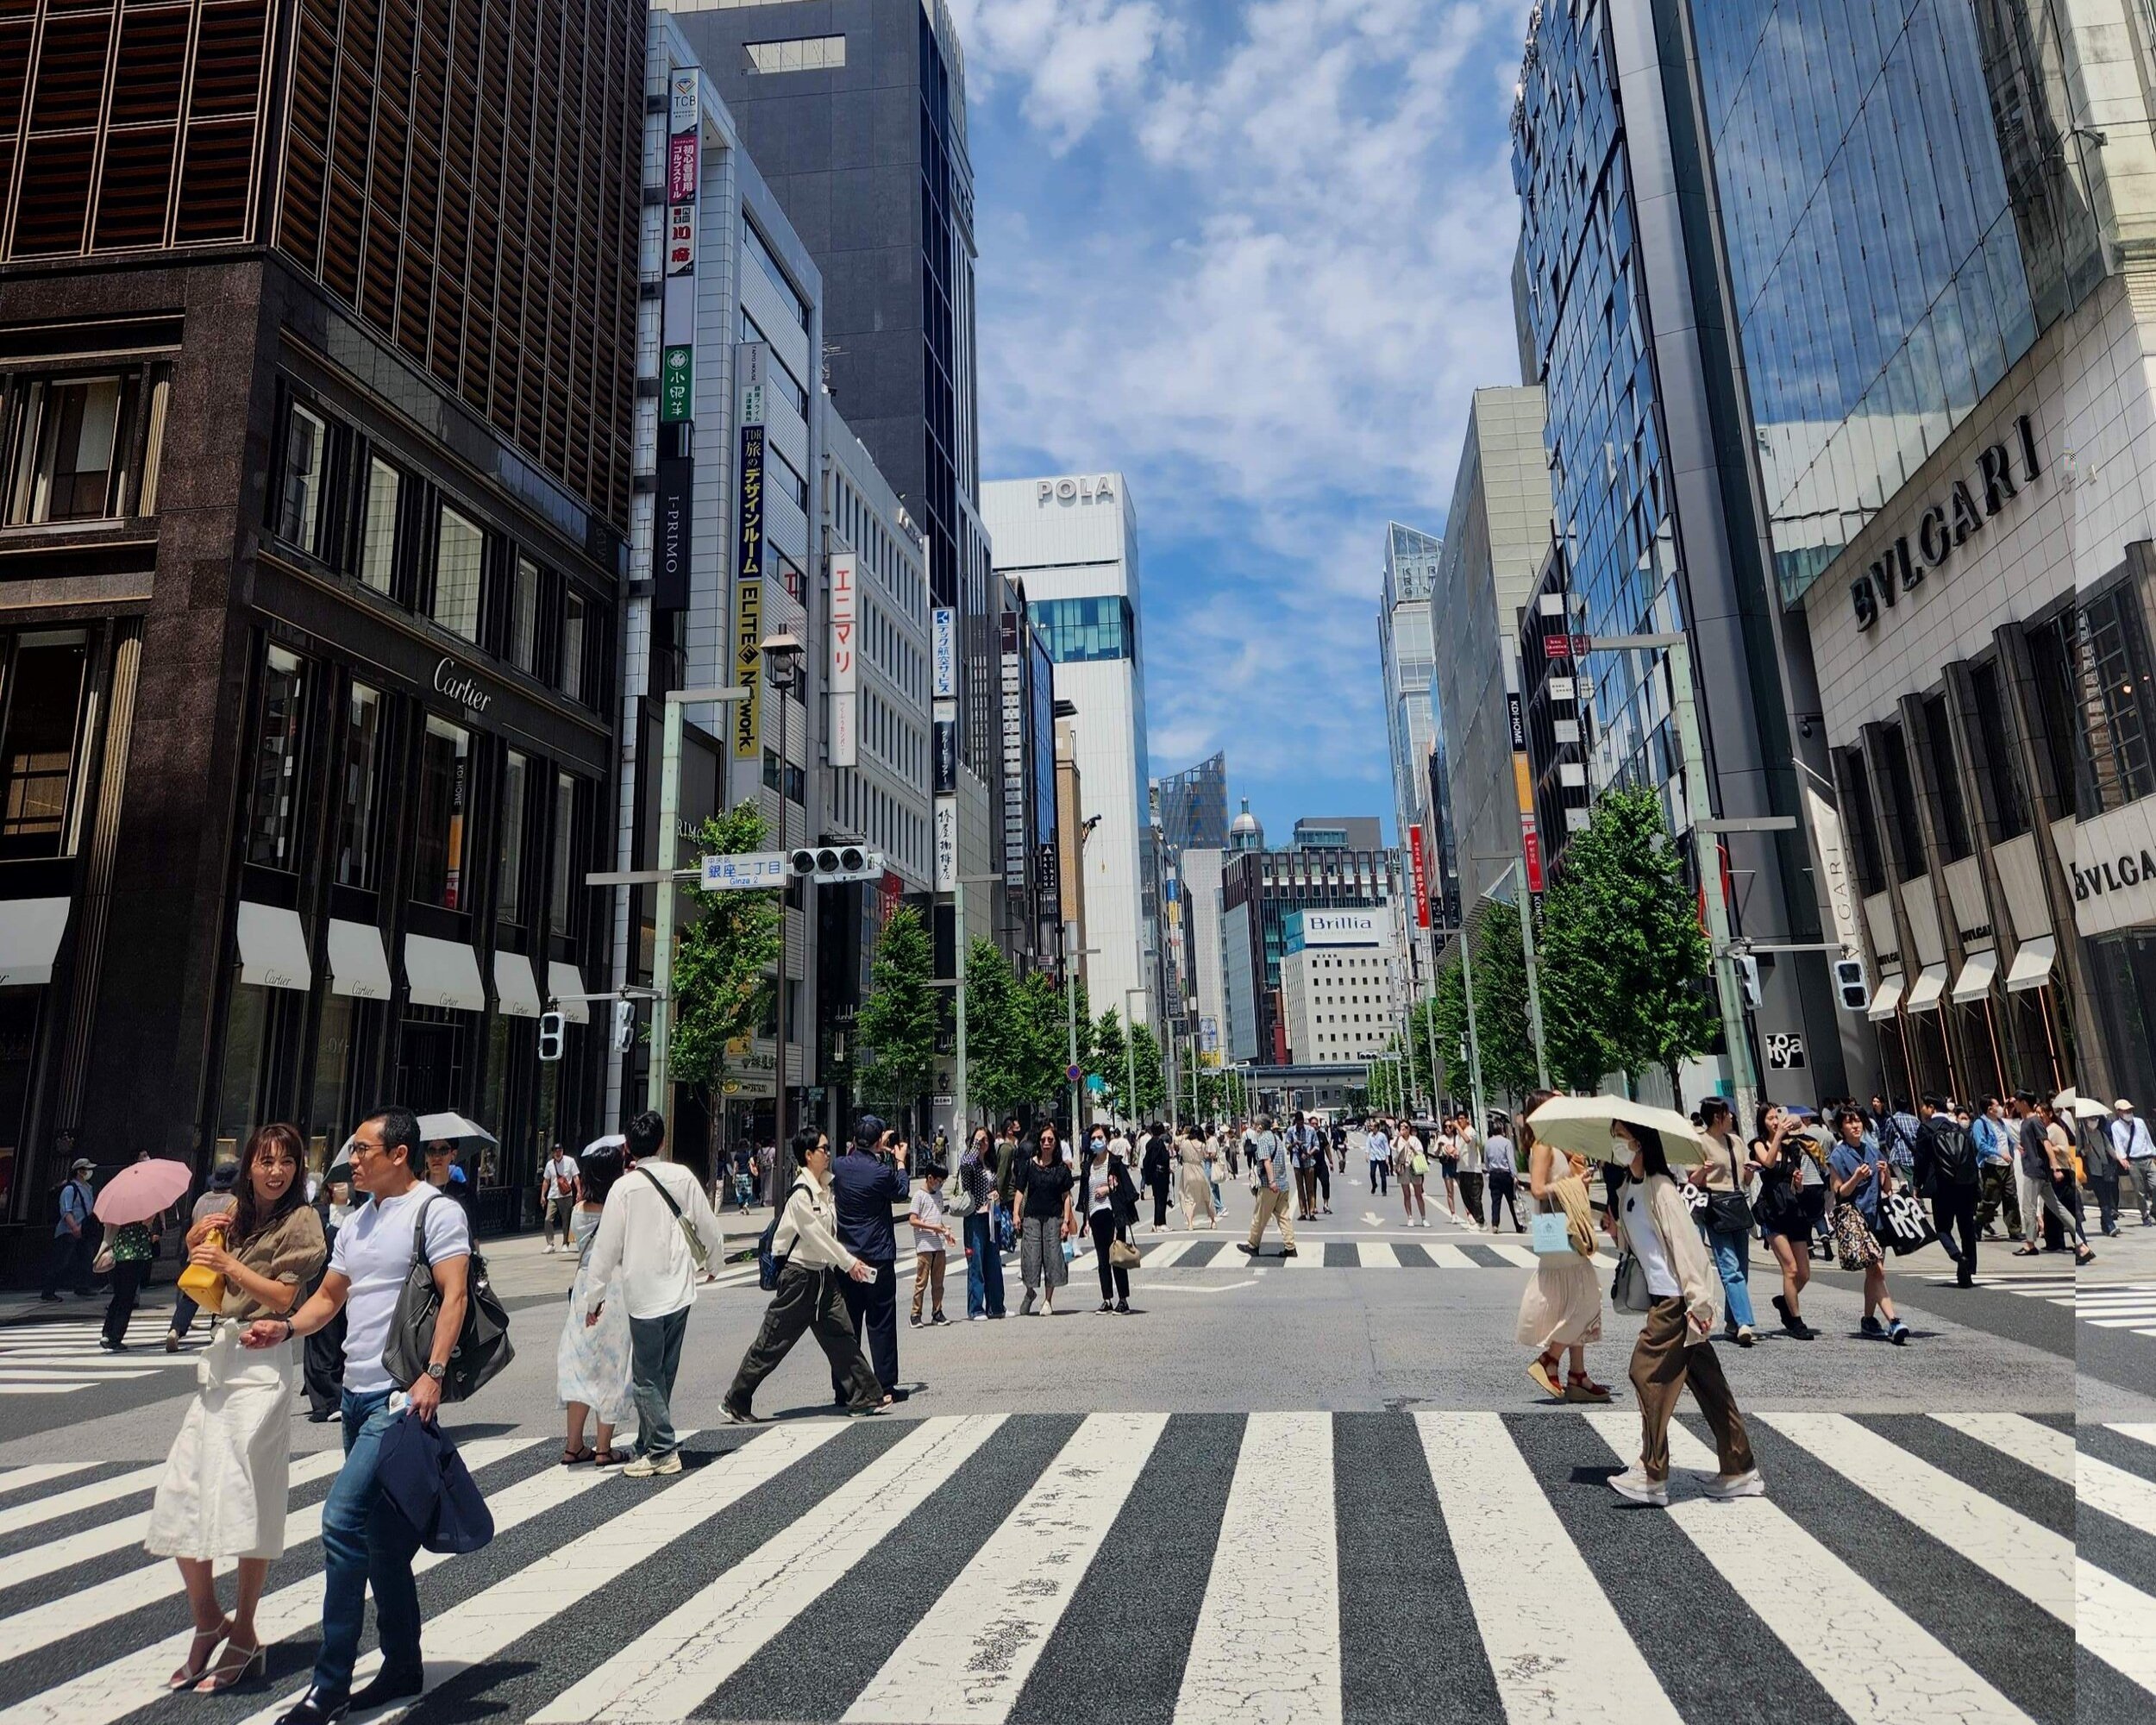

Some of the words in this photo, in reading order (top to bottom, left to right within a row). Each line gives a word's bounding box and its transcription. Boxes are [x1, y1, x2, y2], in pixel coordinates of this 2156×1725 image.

[674, 95, 696, 107] TCB
[673, 146, 682, 198] ゴルフスクール
[669, 372, 685, 416] 小肥羊
[1037, 477, 1113, 499] POLA
[666, 496, 680, 573] I-PRIMO
[1849, 415, 2040, 632] BVLGARI
[741, 587, 758, 645] ELITE
[834, 570, 851, 673] エニマリ
[434, 657, 492, 711] Cartier
[708, 861, 780, 878] 銀座二丁目
[2070, 844, 2156, 902] BVLGA
[1827, 848, 1859, 958] VLGARI
[1311, 917, 1372, 930] Brillia
[264, 969, 291, 986] Cartier
[352, 981, 374, 996] Cartier
[439, 992, 458, 1007] Cartier
[512, 1001, 529, 1014] Cartier
[565, 1008, 579, 1021] Cartier
